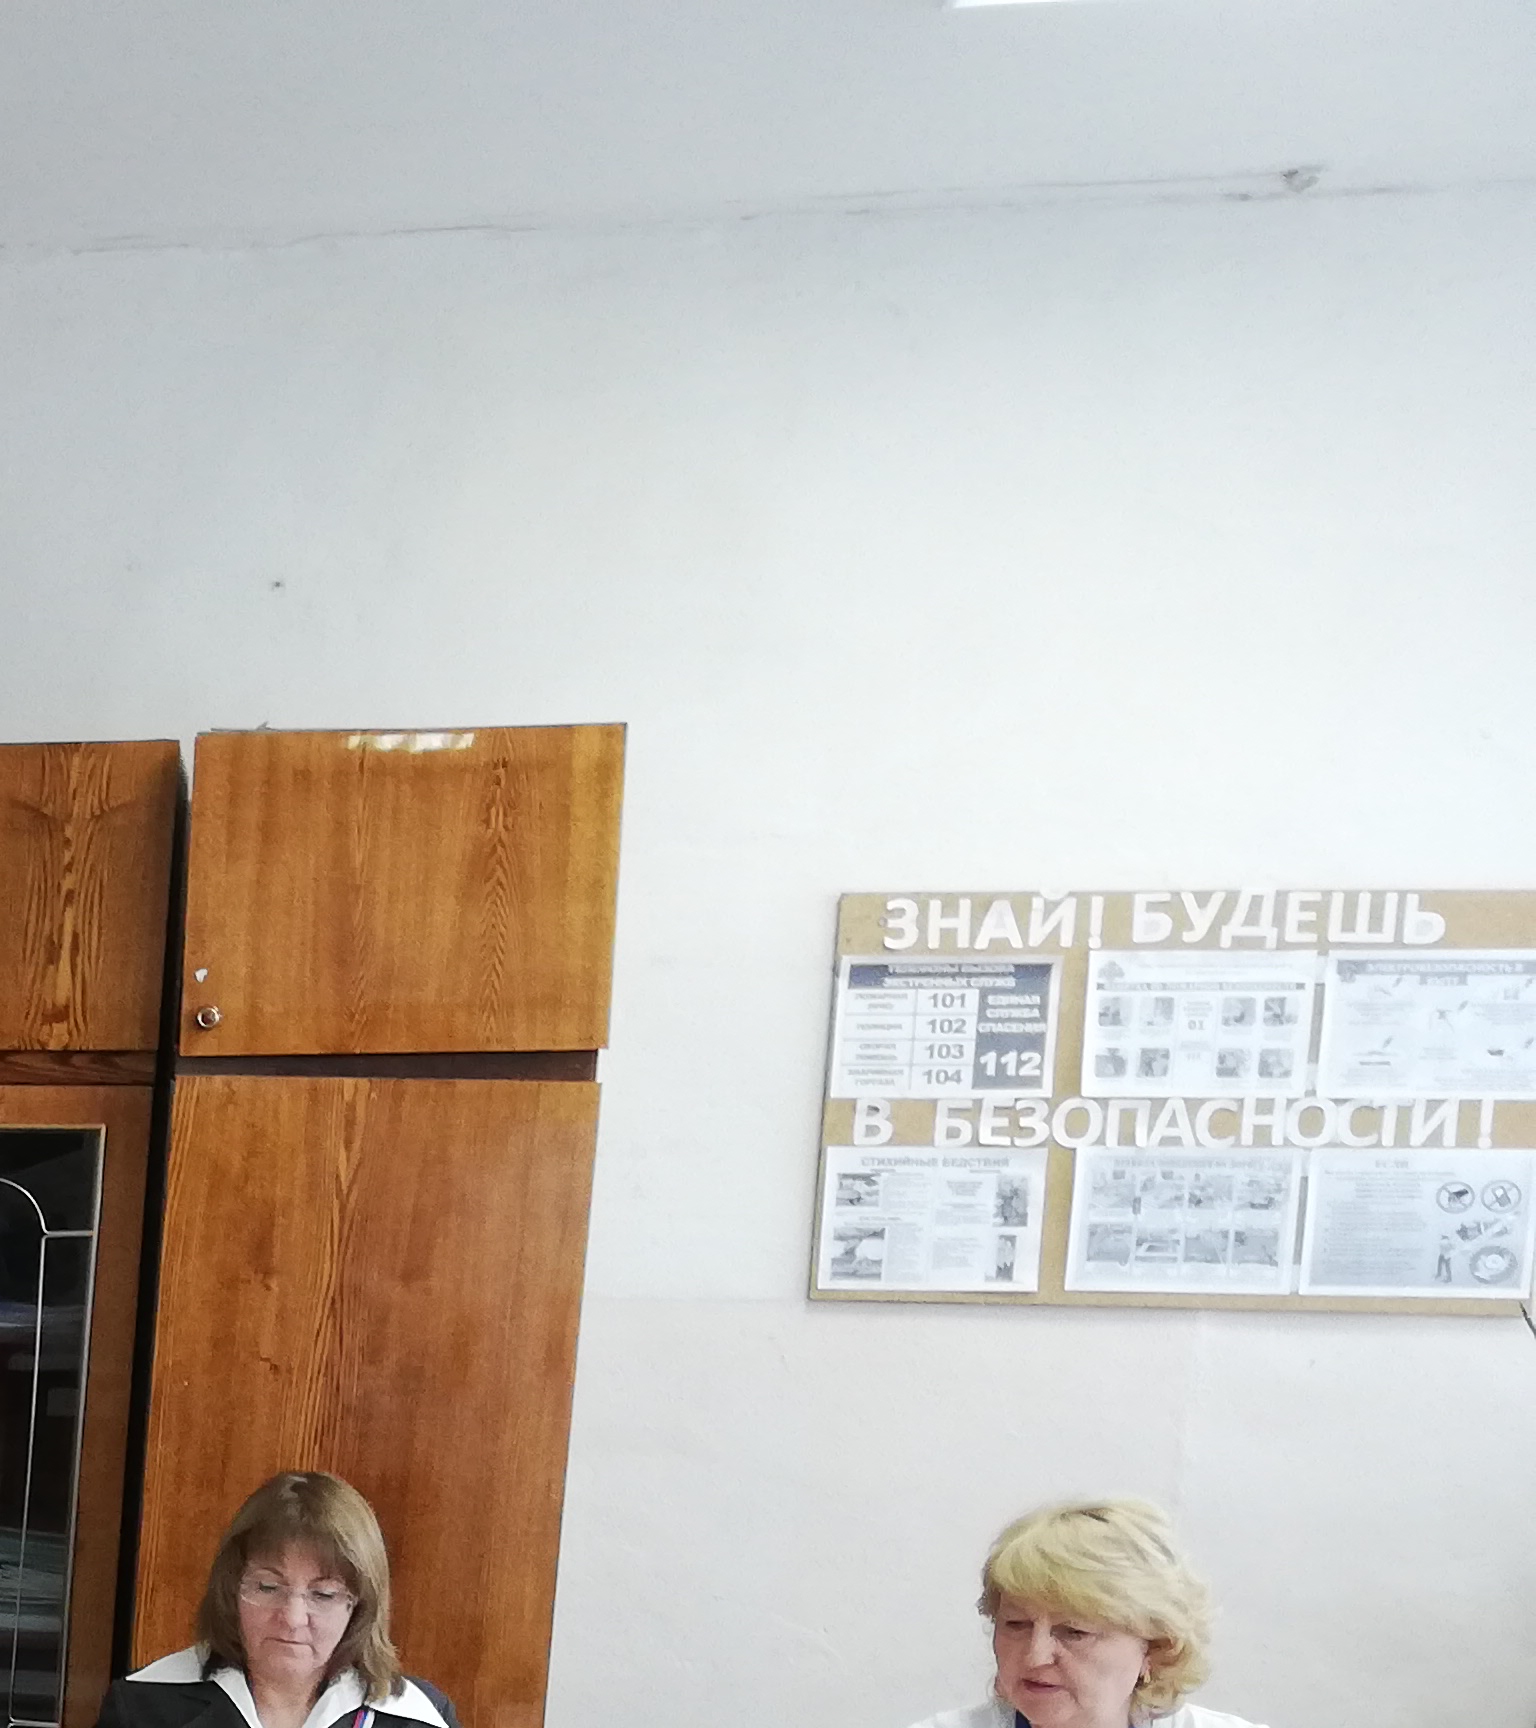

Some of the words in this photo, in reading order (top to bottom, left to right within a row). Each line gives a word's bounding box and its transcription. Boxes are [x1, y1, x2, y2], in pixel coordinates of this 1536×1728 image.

[883, 888, 1104, 950] ЗНАЙ!
[1131, 887, 1446, 950] БУДЕШЬ
[928, 992, 967, 1009] 101
[927, 1018, 967, 1035] 102
[927, 1043, 965, 1060] 103
[979, 1050, 1043, 1078] 112
[922, 1069, 963, 1086] 104
[852, 1097, 894, 1148] В
